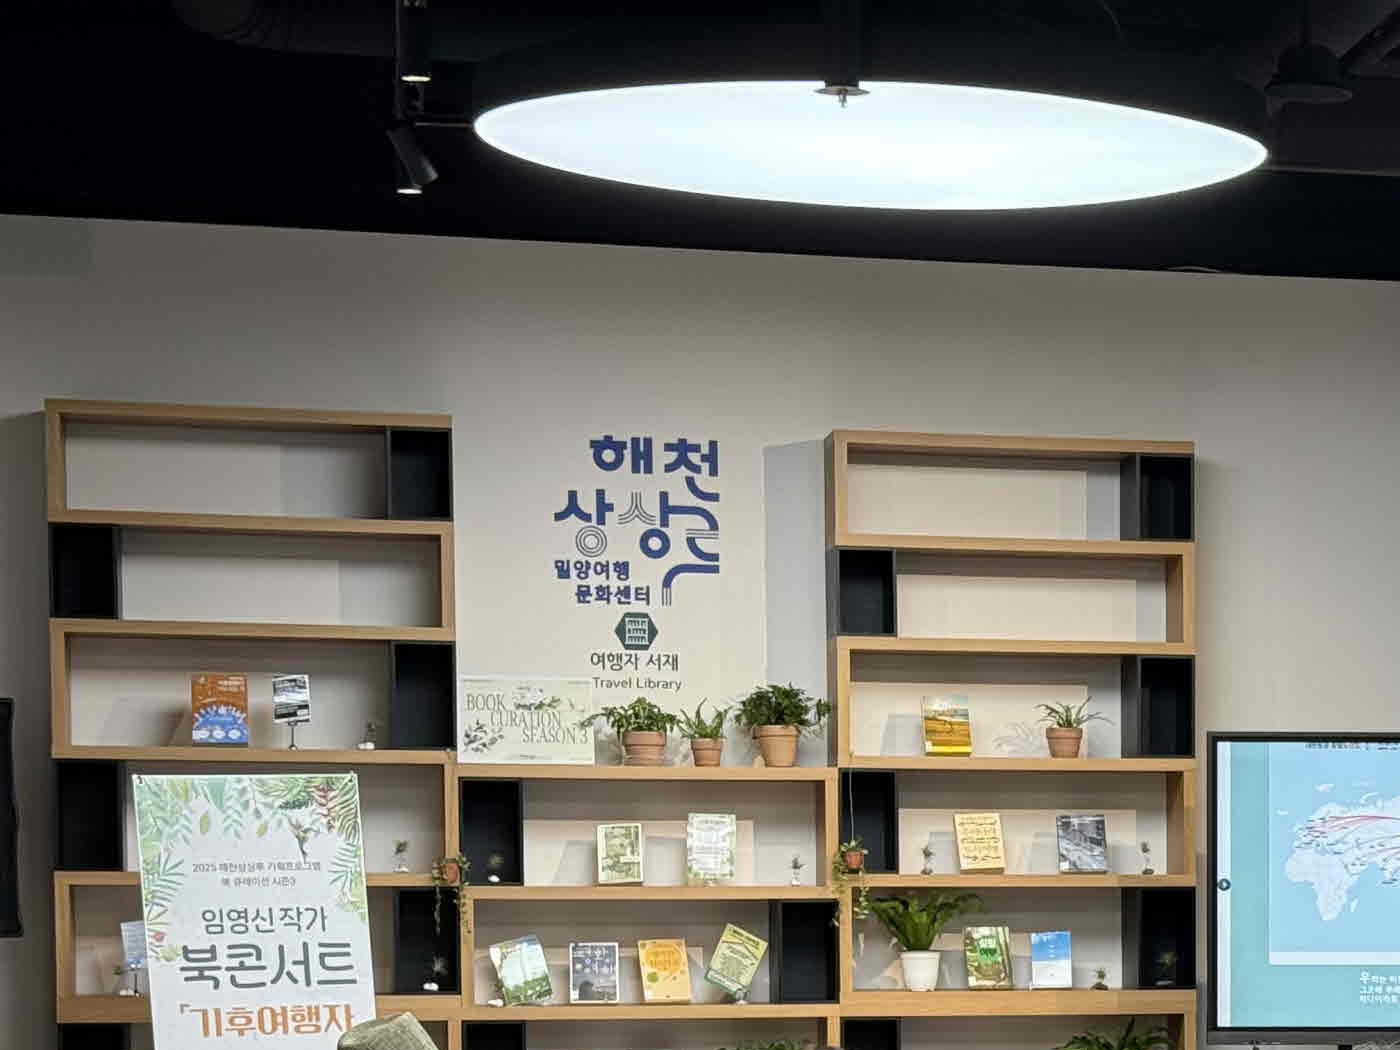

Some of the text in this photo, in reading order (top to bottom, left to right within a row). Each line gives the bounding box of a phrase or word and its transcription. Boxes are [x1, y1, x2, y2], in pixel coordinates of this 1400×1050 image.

[554, 560, 630, 580] 밀양여행
[575, 584, 650, 605] 문화센터
[590, 652, 679, 671] 여행자 서재
[592, 677, 682, 691] Travel Library
[466, 693, 507, 712] BOOK
[490, 710, 562, 728] CURATION
[522, 727, 588, 744] SEASON 3
[202, 906, 328, 935] 임영신 작가
[179, 941, 357, 990] 북콘서트
